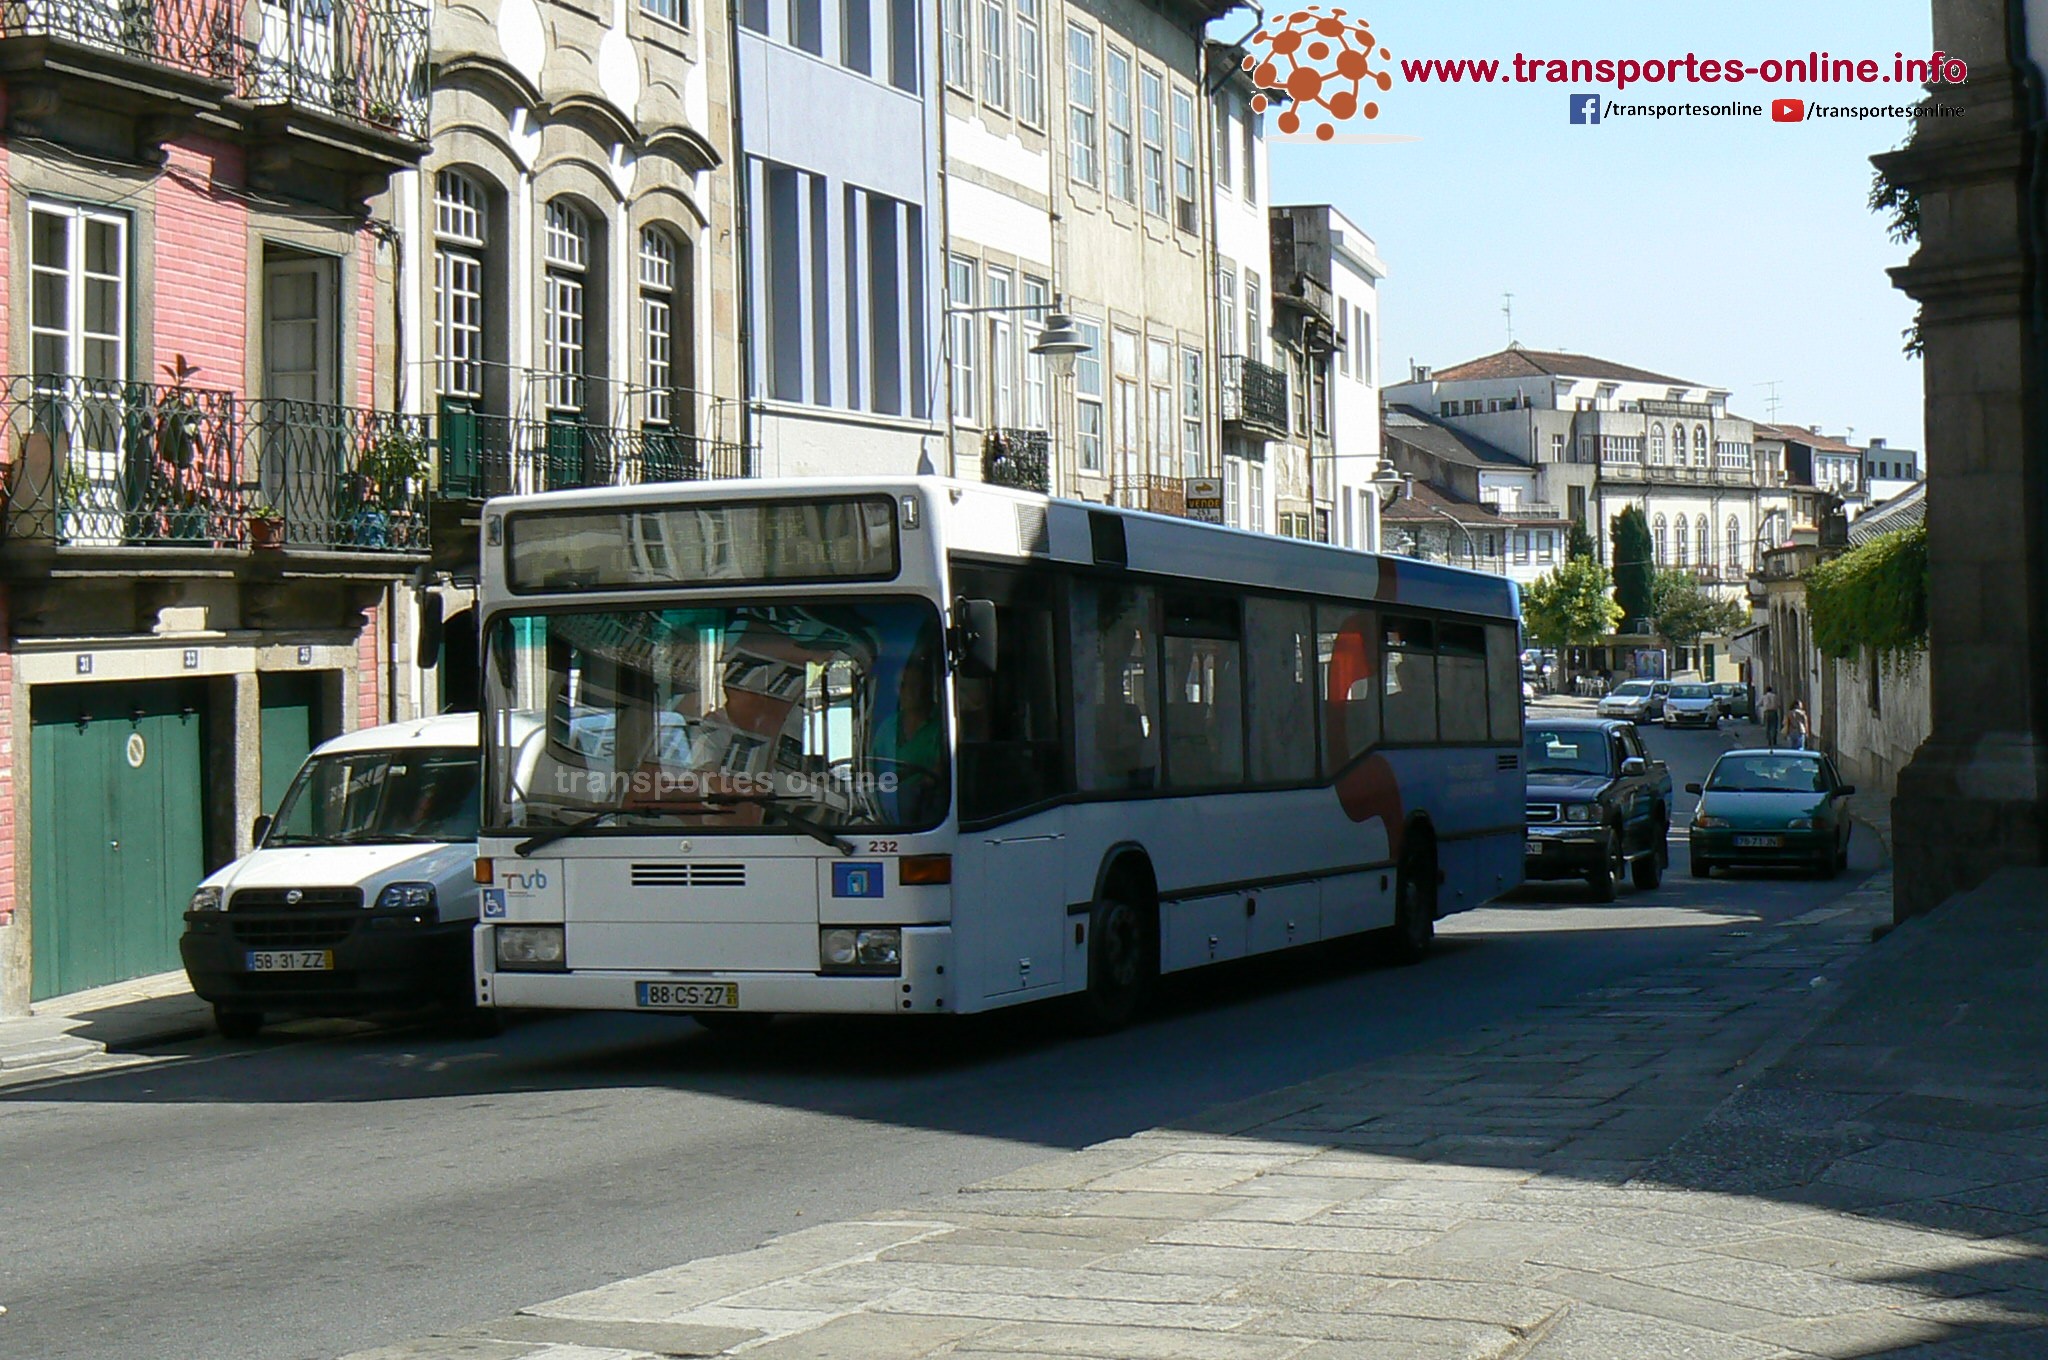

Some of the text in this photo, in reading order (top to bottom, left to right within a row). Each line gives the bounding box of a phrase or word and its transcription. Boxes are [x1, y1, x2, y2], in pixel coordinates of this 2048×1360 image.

[79, 656, 90, 672] 31
[185, 651, 196, 668] 33
[869, 841, 898, 853] 232
